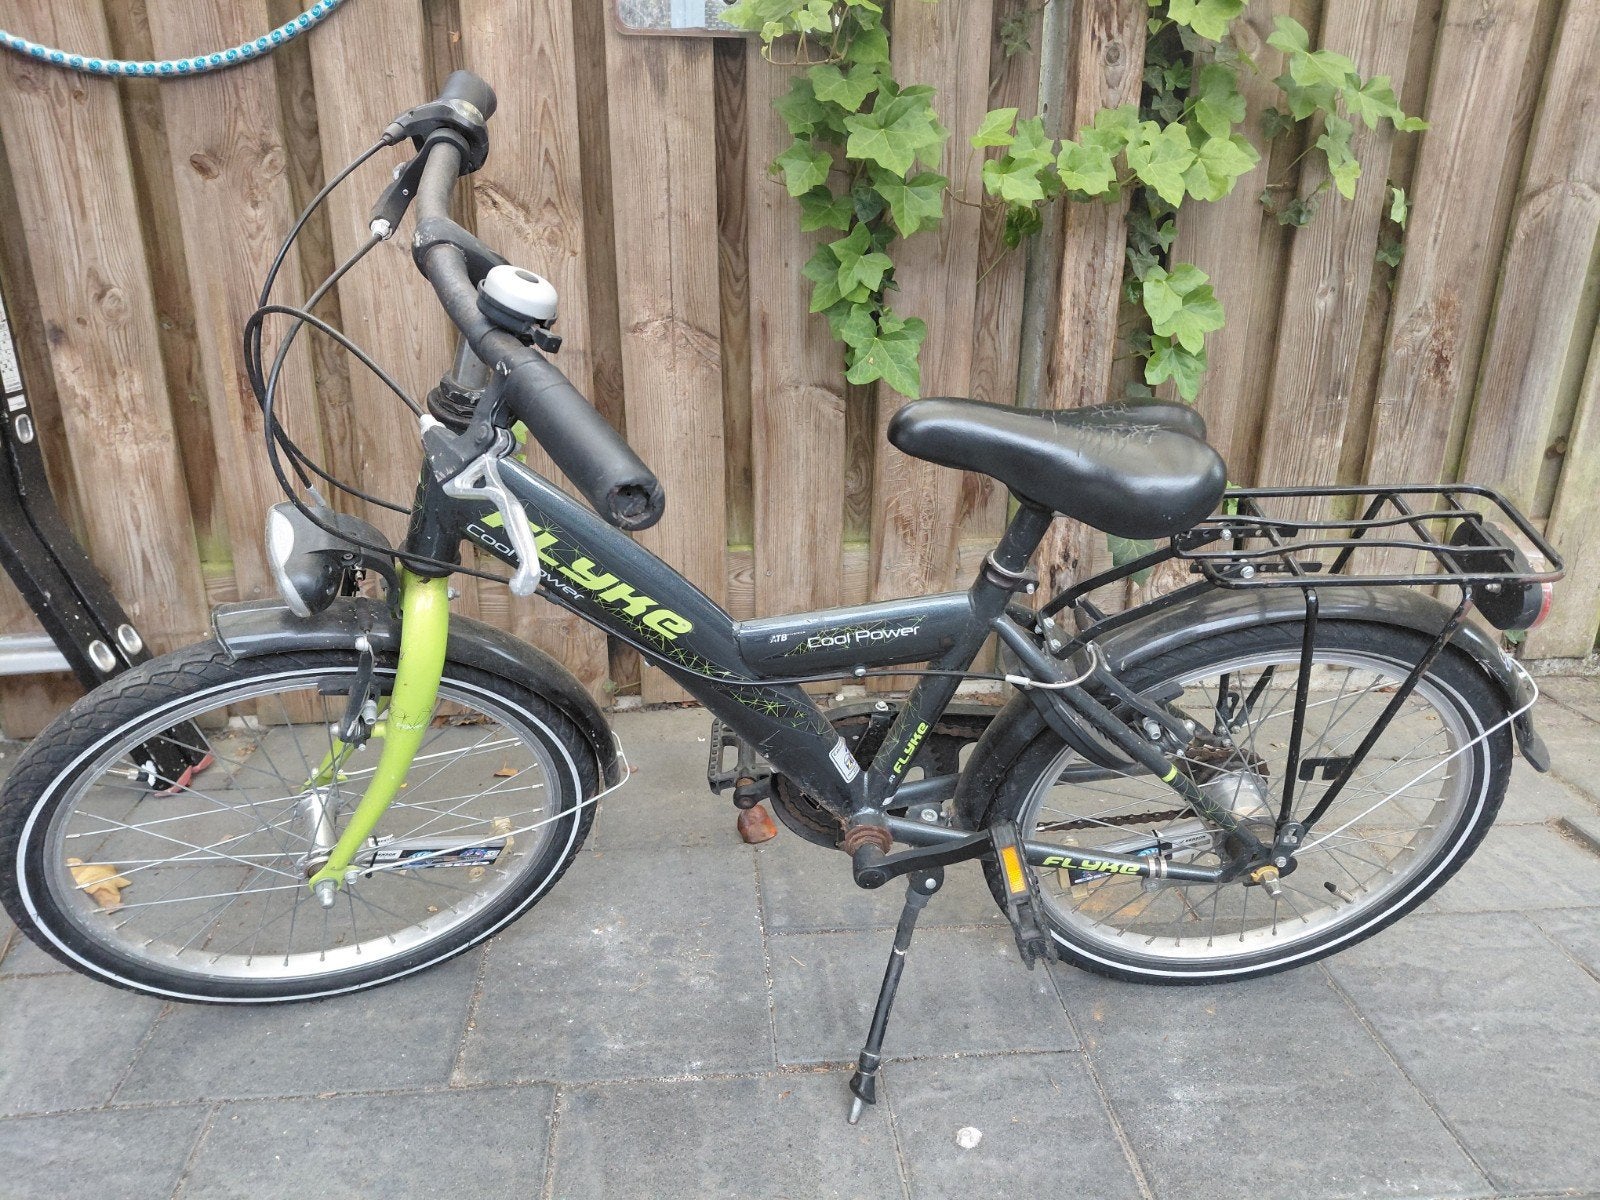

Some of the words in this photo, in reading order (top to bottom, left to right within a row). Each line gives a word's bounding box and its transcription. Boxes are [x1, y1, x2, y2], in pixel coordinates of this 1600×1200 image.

[769, 633, 788, 644] ATB
[807, 633, 851, 649] Cool
[855, 625, 920, 642] Power
